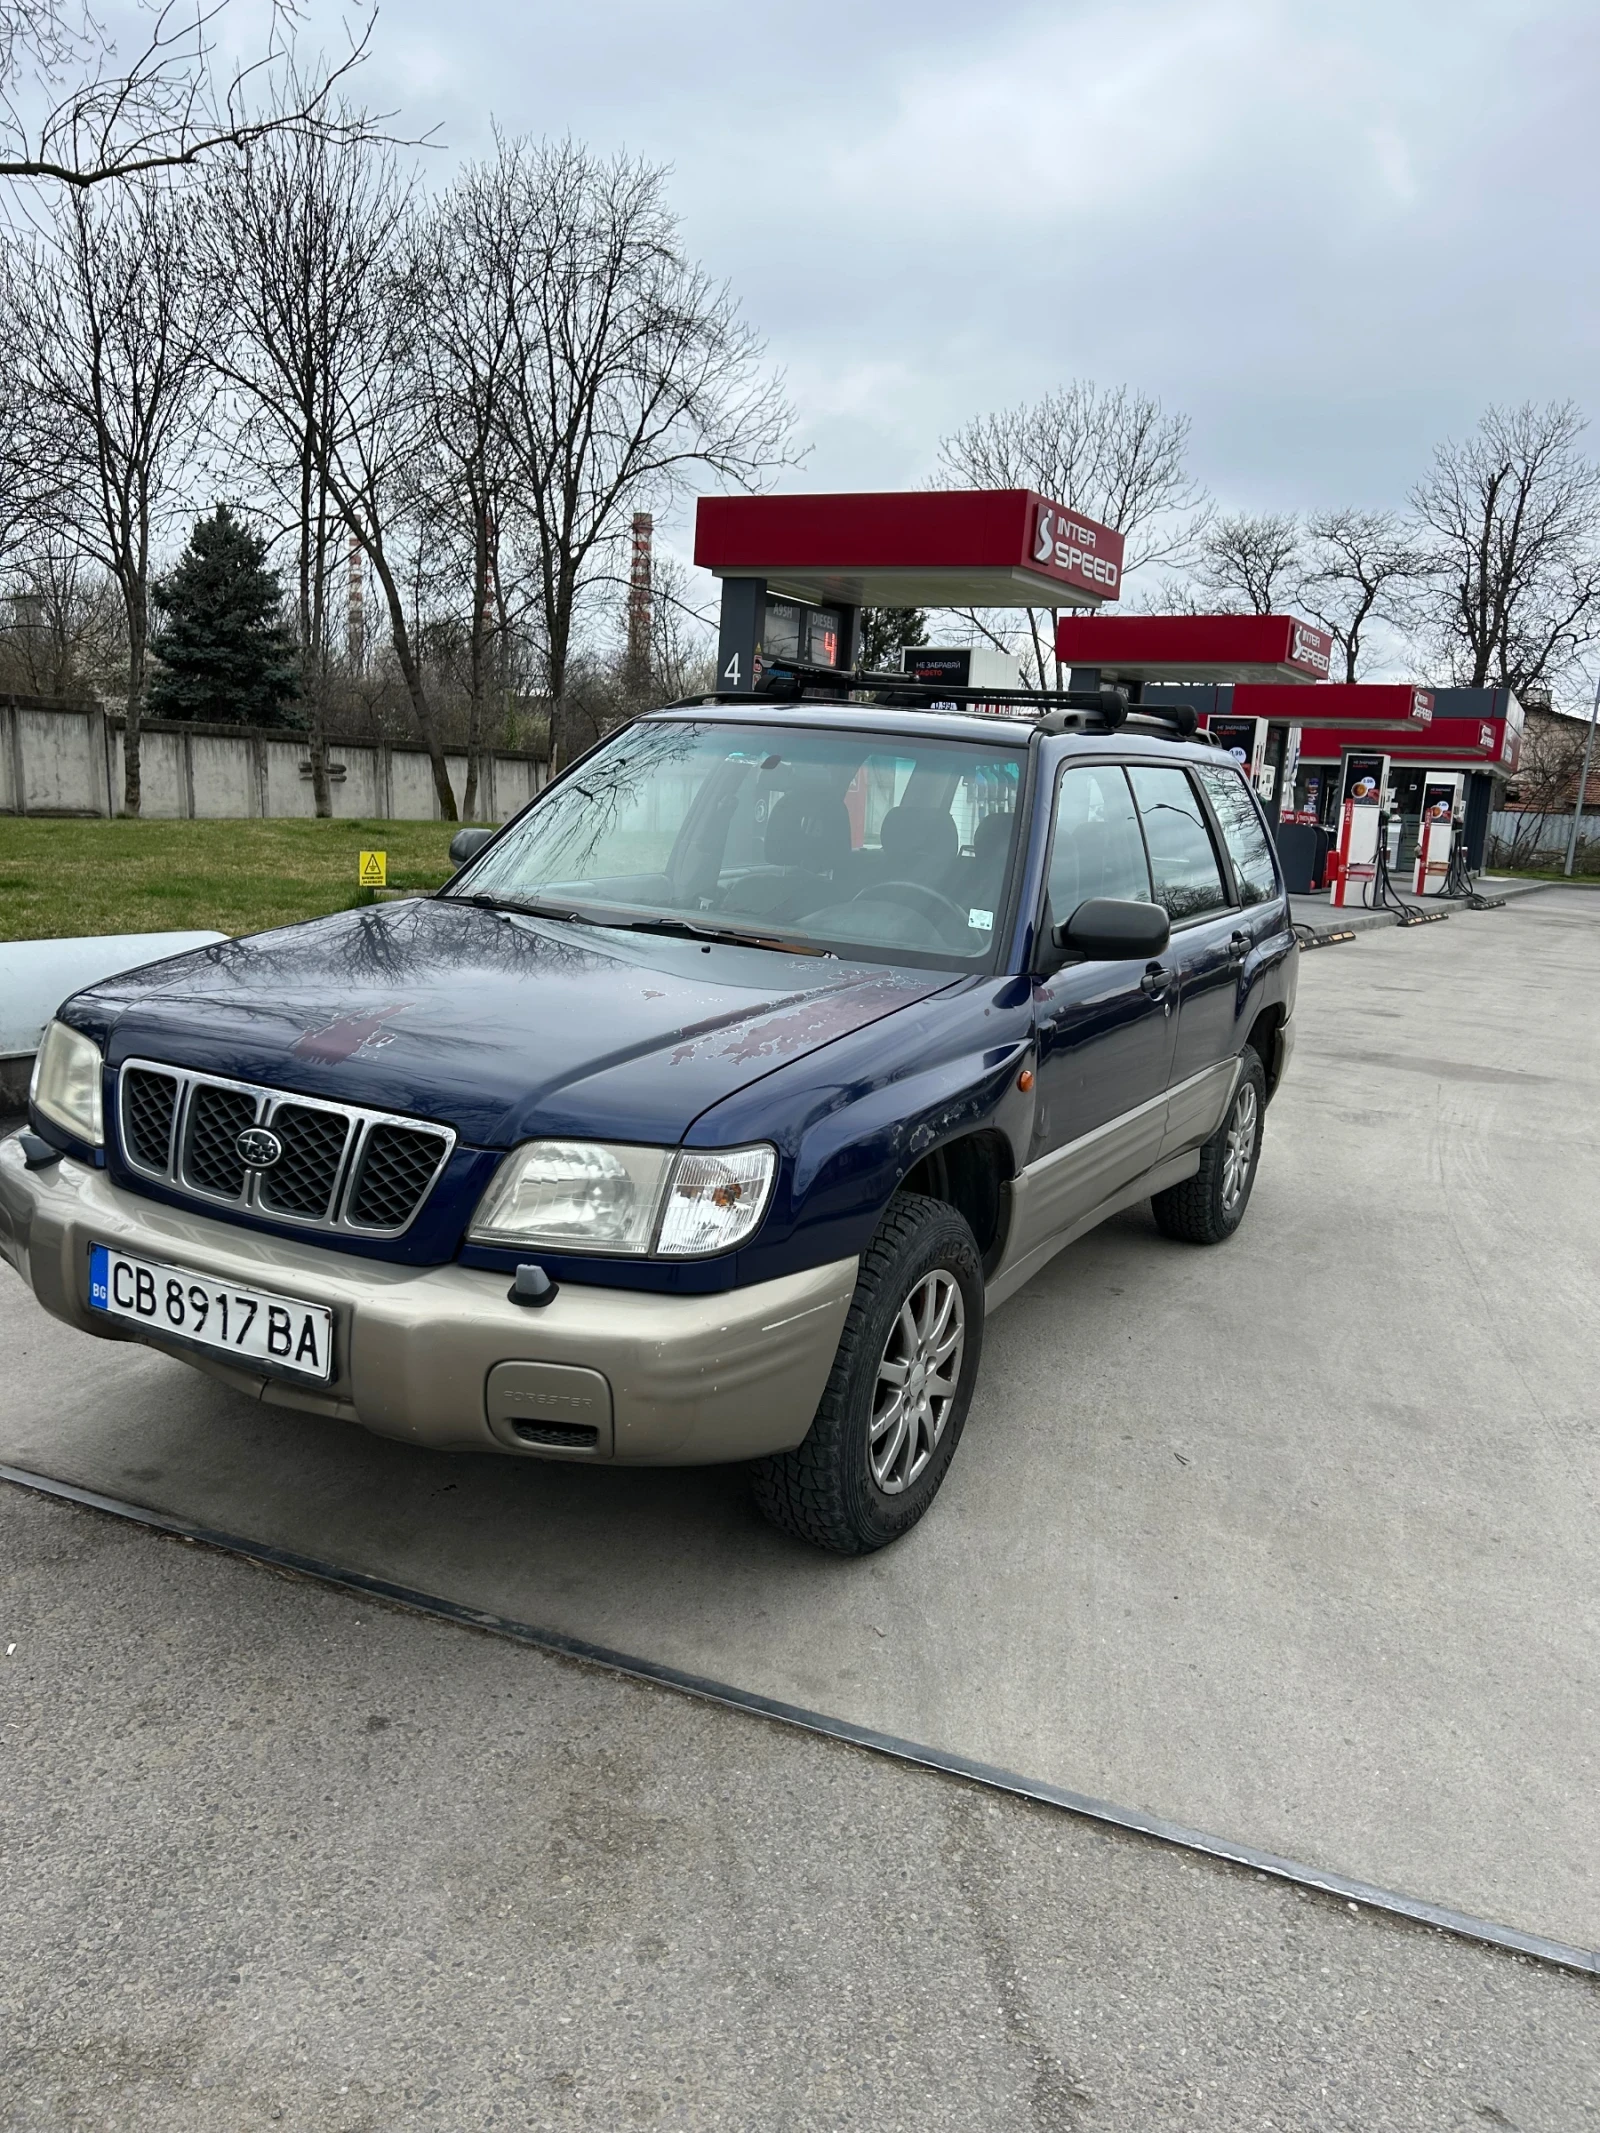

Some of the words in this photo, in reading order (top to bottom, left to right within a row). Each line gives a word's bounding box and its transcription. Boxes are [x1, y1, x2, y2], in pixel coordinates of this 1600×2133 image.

[1057, 516, 1097, 549] INTER
[1055, 541, 1118, 587] SPEED
[812, 612, 835, 630] DIESEL
[724, 652, 741, 686] 4
[915, 661, 926, 669] НЕ
[926, 660, 961, 669] ЗАБРАВЯЙ
[1300, 645, 1330, 672] SPEED
[92, 1282, 108, 1300] BG
[113, 1261, 157, 1317] CB
[165, 1278, 258, 1345] 8917
[268, 1304, 320, 1367] BA
[503, 1390, 593, 1408] FORESTER
